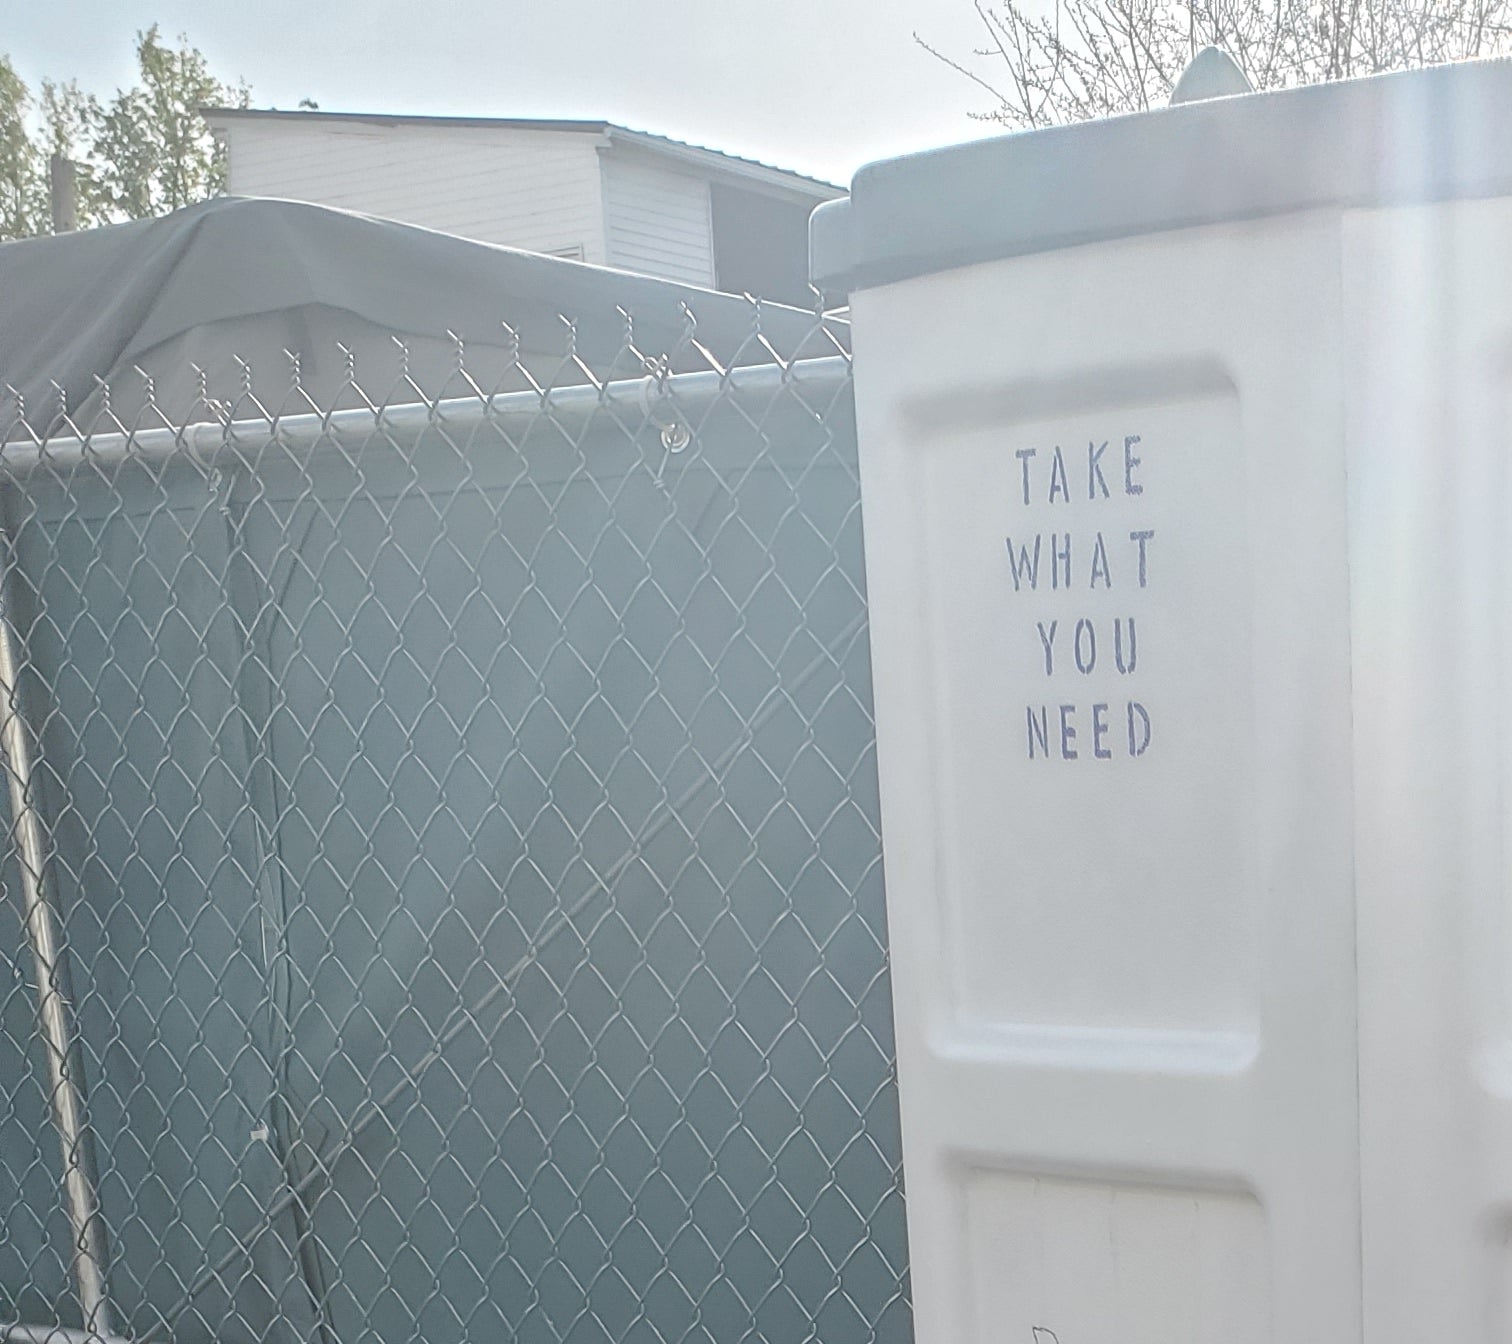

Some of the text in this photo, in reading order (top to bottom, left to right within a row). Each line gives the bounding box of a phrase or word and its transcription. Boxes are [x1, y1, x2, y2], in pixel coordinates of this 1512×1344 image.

[1015, 435, 1143, 505] TAKE
[1006, 530, 1154, 591] WHAT
[1037, 617, 1136, 676] YOU
[1026, 701, 1151, 760] NEED
